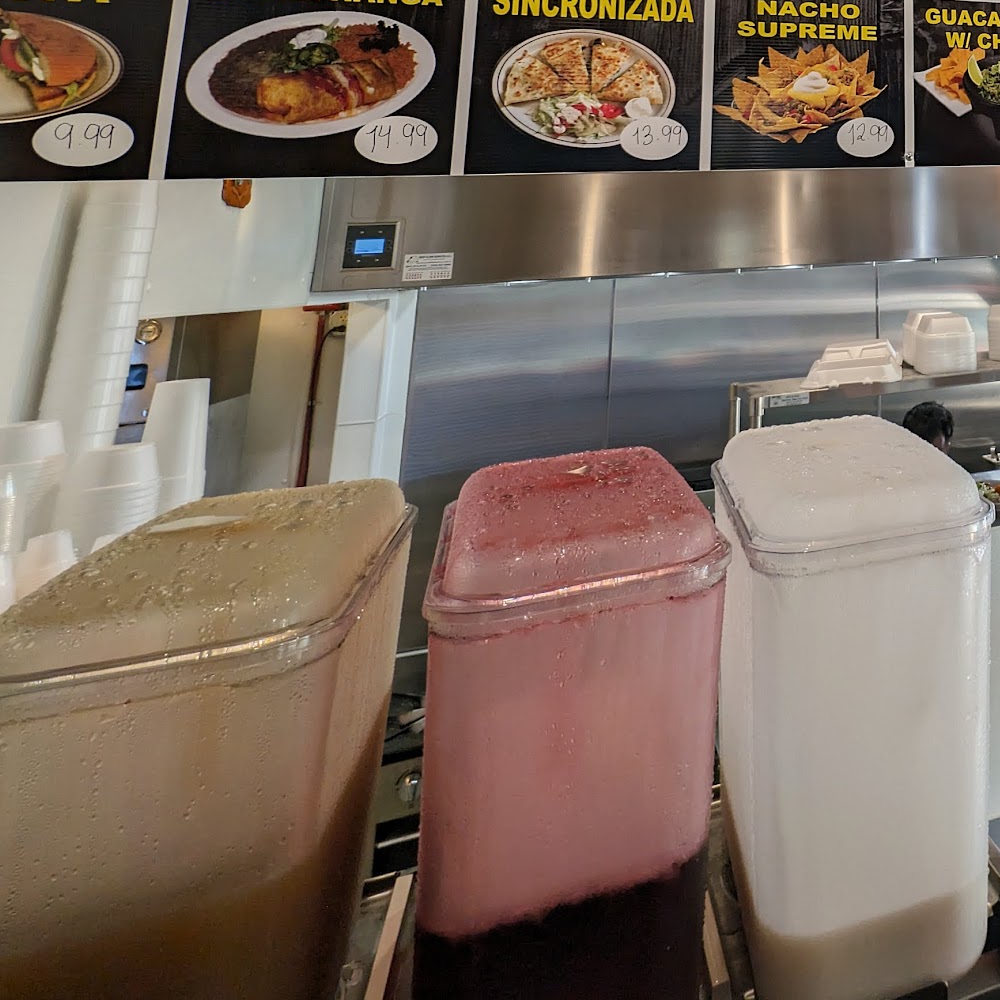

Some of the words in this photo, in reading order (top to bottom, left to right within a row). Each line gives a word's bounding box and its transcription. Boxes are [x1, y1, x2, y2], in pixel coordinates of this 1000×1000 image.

[757, 0, 860, 20] NACHO
[737, 21, 878, 41] SUPREME
[945, 31, 971, 50] W/
[54, 124, 115, 150] 9.99
[366, 125, 428, 153] 14.99
[632, 125, 683, 146] 13.99
[848, 123, 889, 143] 12.99
